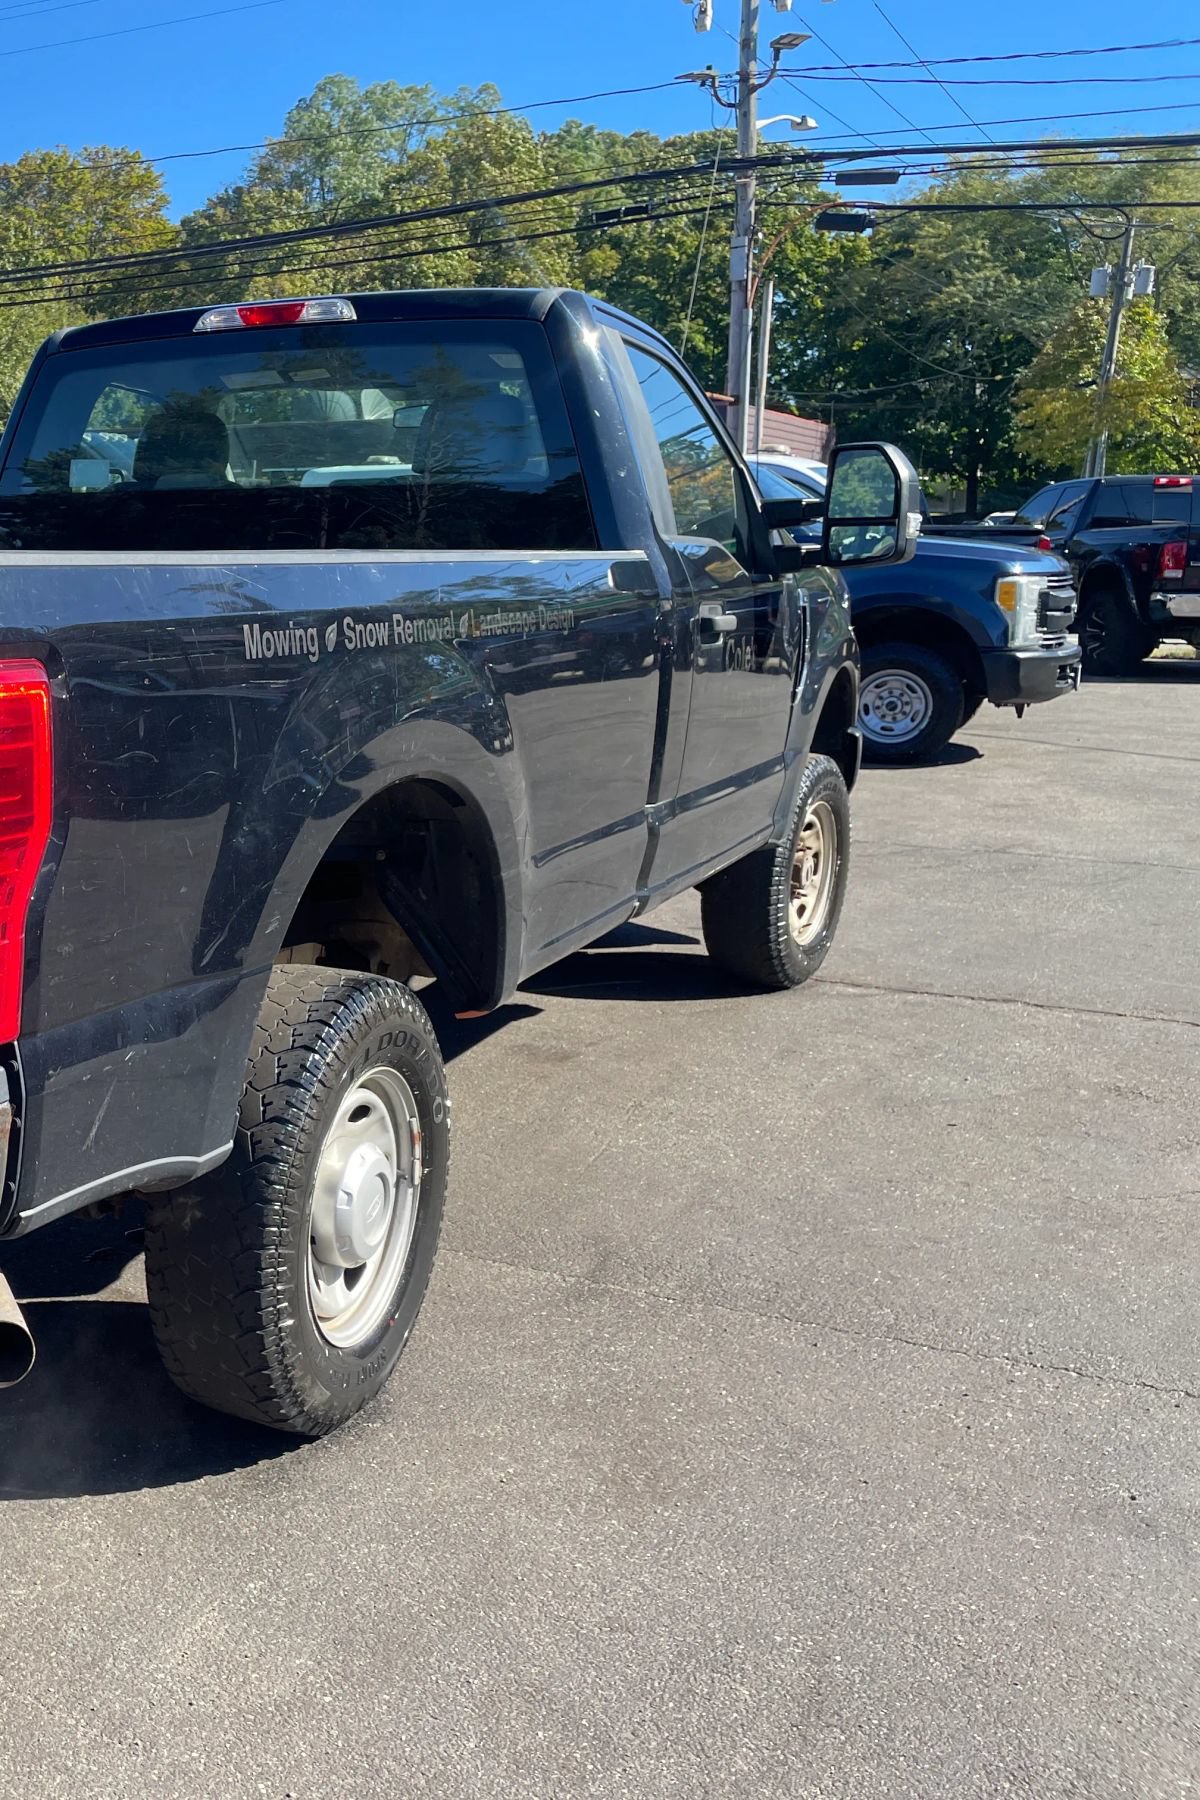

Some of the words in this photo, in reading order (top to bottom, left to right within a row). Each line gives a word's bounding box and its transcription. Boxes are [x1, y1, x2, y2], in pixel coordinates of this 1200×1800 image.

[243, 621, 319, 662] Mowing
[343, 616, 389, 650] Snow
[392, 609, 456, 645] Removal
[471, 606, 536, 640] Landscape
[539, 604, 575, 635] Design
